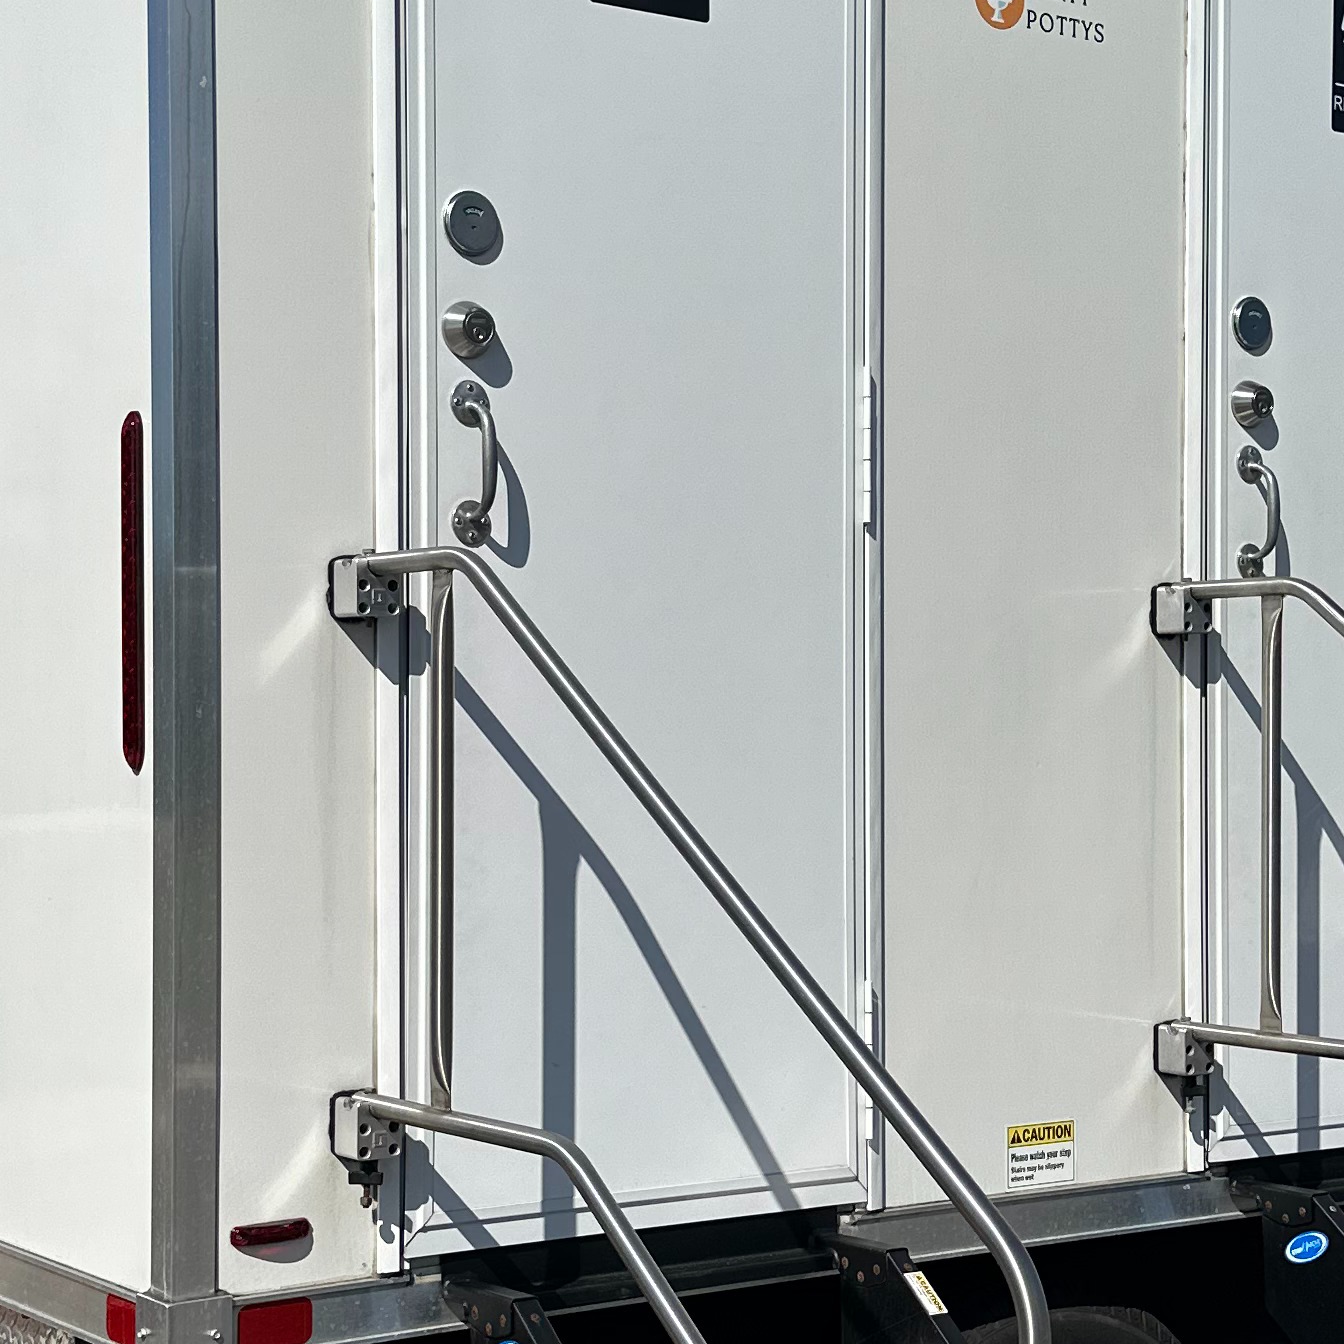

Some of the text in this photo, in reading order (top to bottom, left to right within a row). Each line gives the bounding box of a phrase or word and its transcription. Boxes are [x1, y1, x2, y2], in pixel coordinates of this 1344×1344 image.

[1027, 8, 1105, 44] POTTYS
[1022, 1124, 1071, 1142] CAUTION
[1011, 1153, 1028, 1163] Please
[1030, 1150, 1045, 1160] watch
[1047, 1151, 1058, 1160] your
